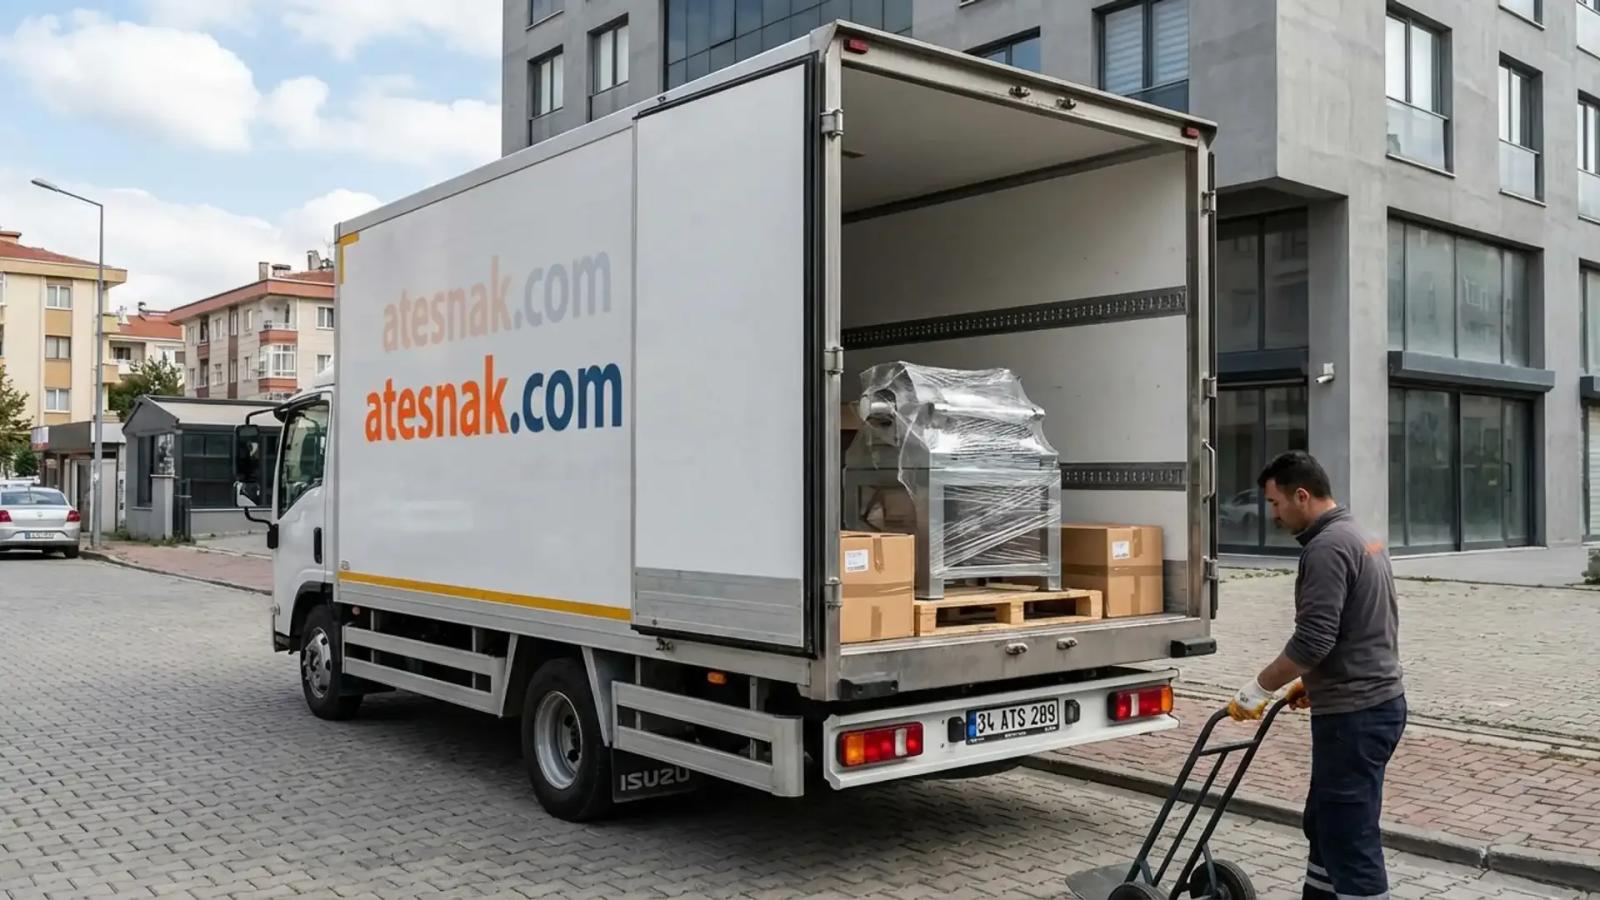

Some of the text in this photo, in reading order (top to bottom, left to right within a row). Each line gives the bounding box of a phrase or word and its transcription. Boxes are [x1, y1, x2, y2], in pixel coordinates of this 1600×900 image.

[383, 250, 611, 352] atesnak.com
[365, 354, 622, 442] atesnak.com
[978, 704, 1056, 733] 34 ATS 289
[620, 766, 690, 791] ISUZU
